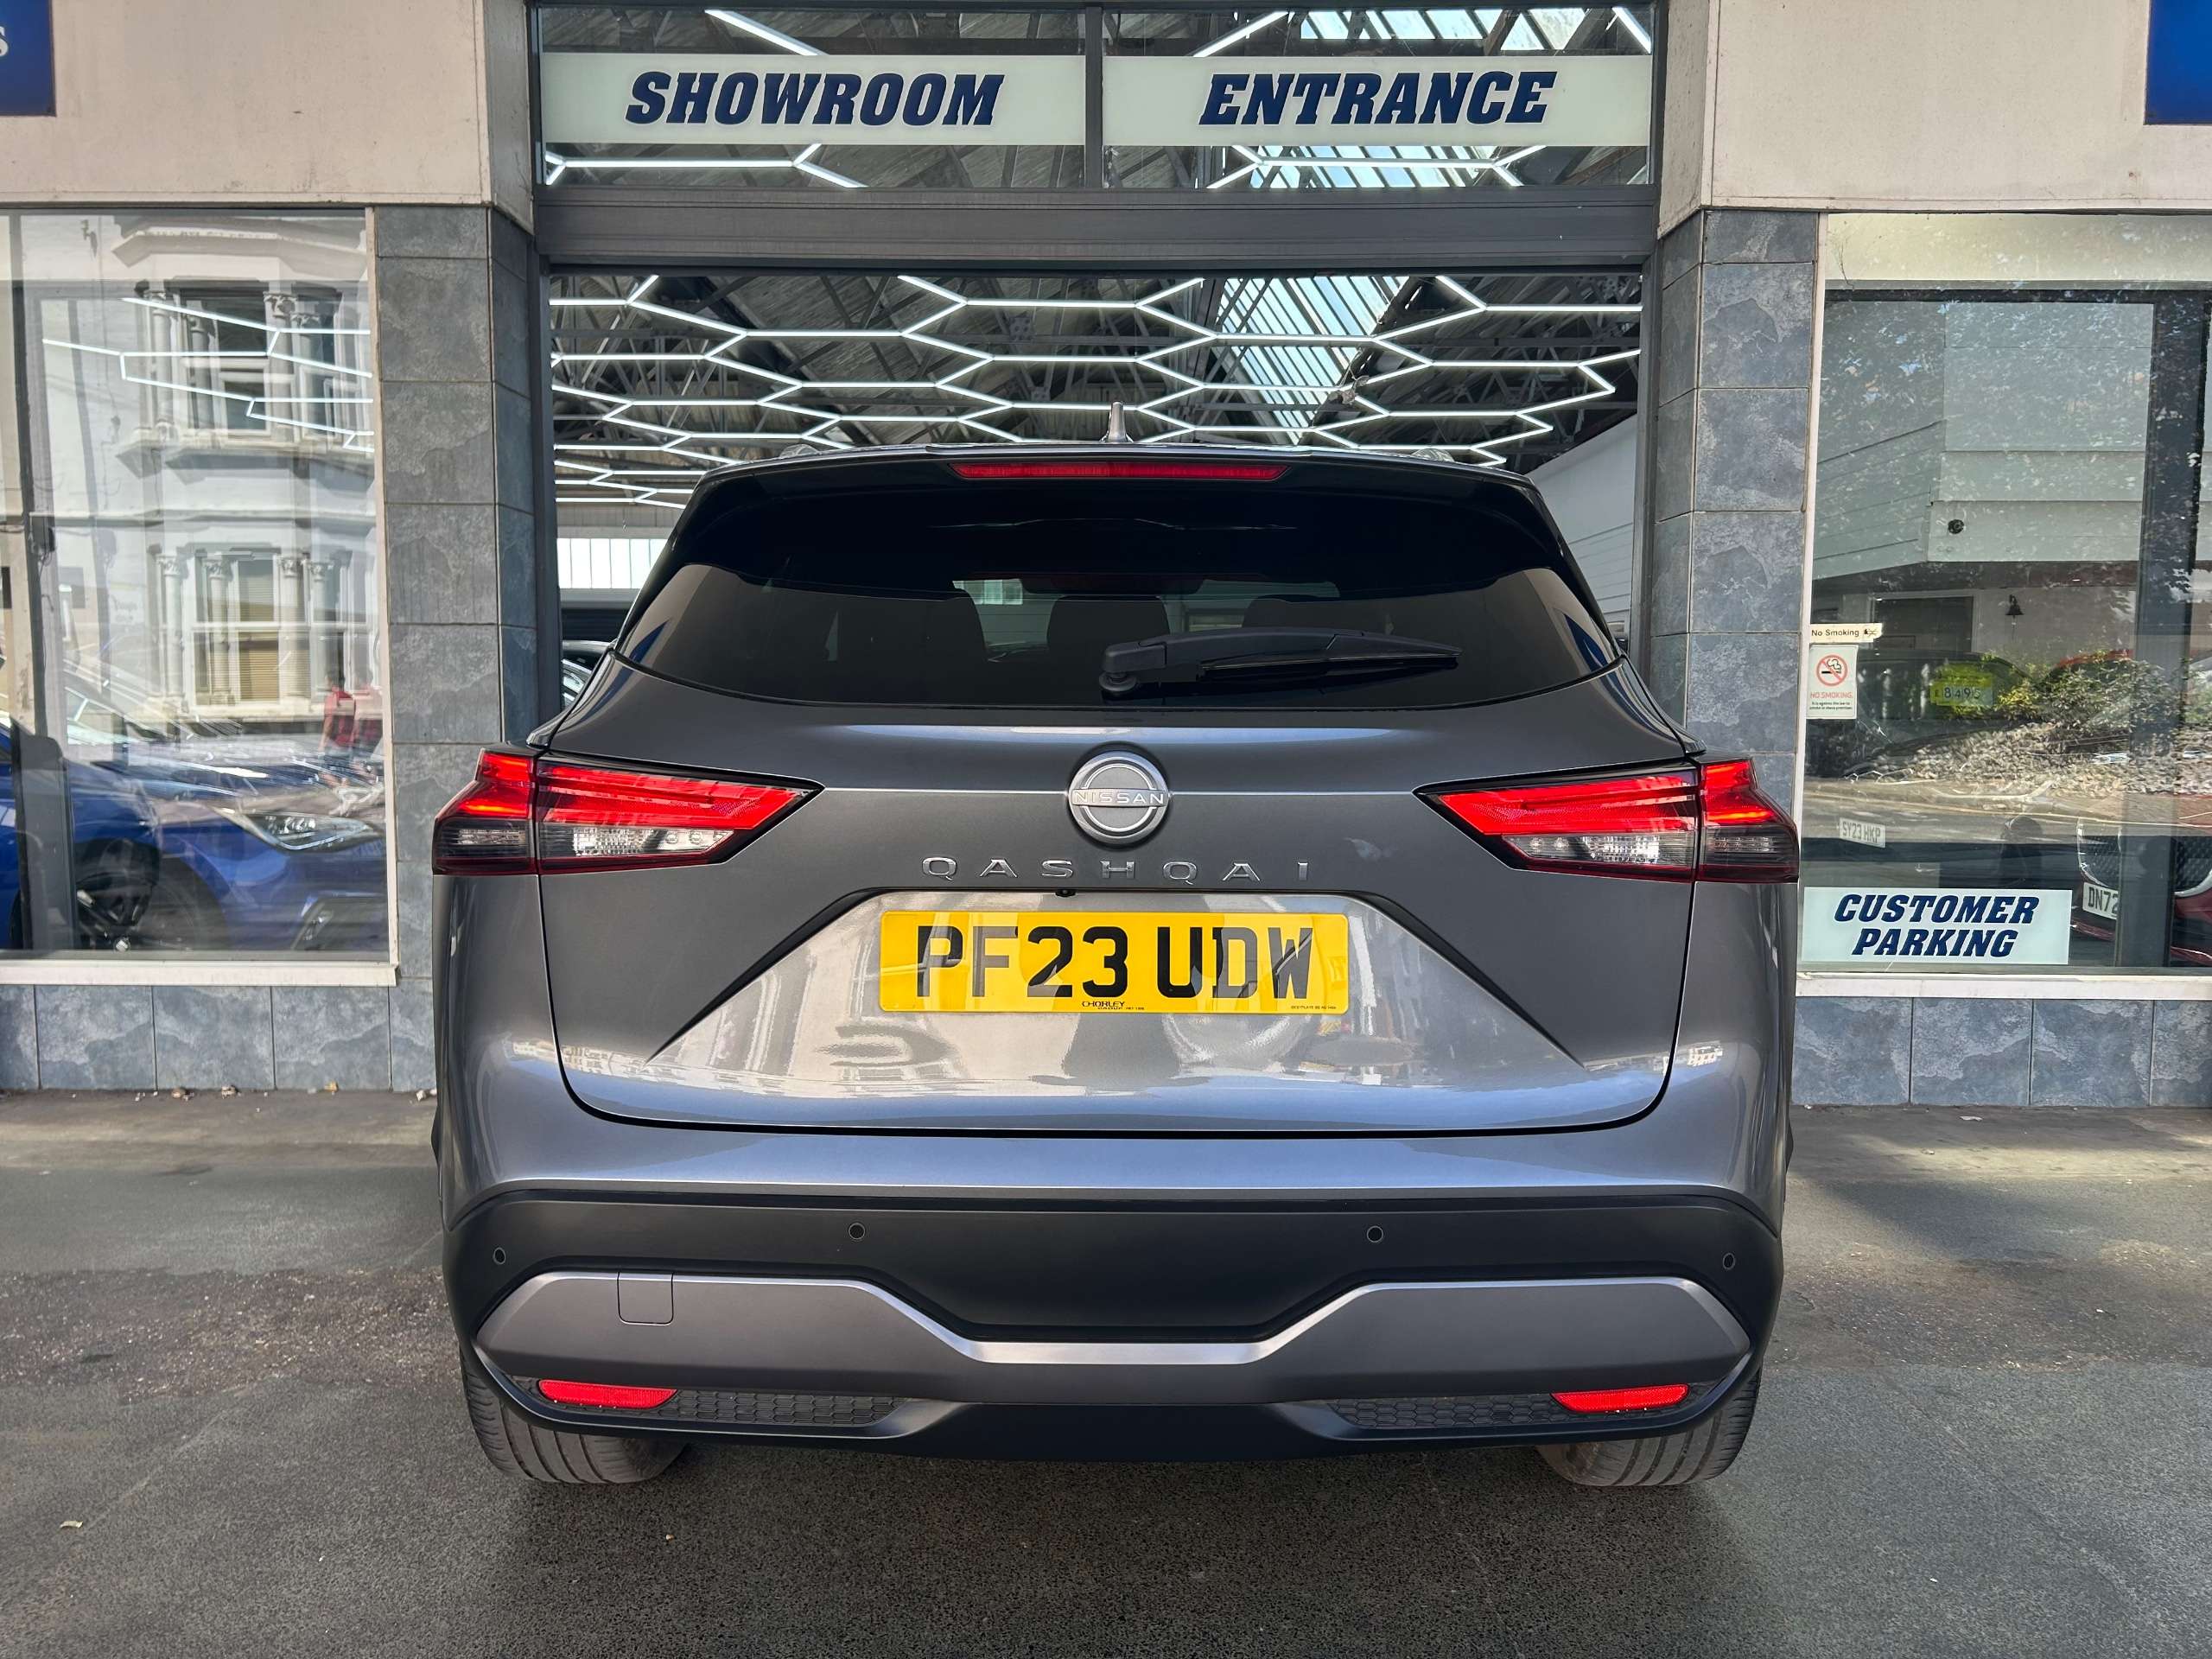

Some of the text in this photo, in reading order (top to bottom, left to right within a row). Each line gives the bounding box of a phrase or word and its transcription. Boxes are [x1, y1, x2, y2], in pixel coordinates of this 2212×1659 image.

[625, 71, 1558, 126] SHOWROOM ENTRANCE
[1825, 628, 1859, 637] Smoking
[1073, 790, 1165, 805] NISSAN
[1842, 821, 1862, 840] SY23
[920, 855, 1309, 884] QASHQAI
[1834, 893, 2040, 925] CUSTOMER
[1851, 928, 2019, 958] PARKING
[916, 925, 1313, 999] PF23 UDW
